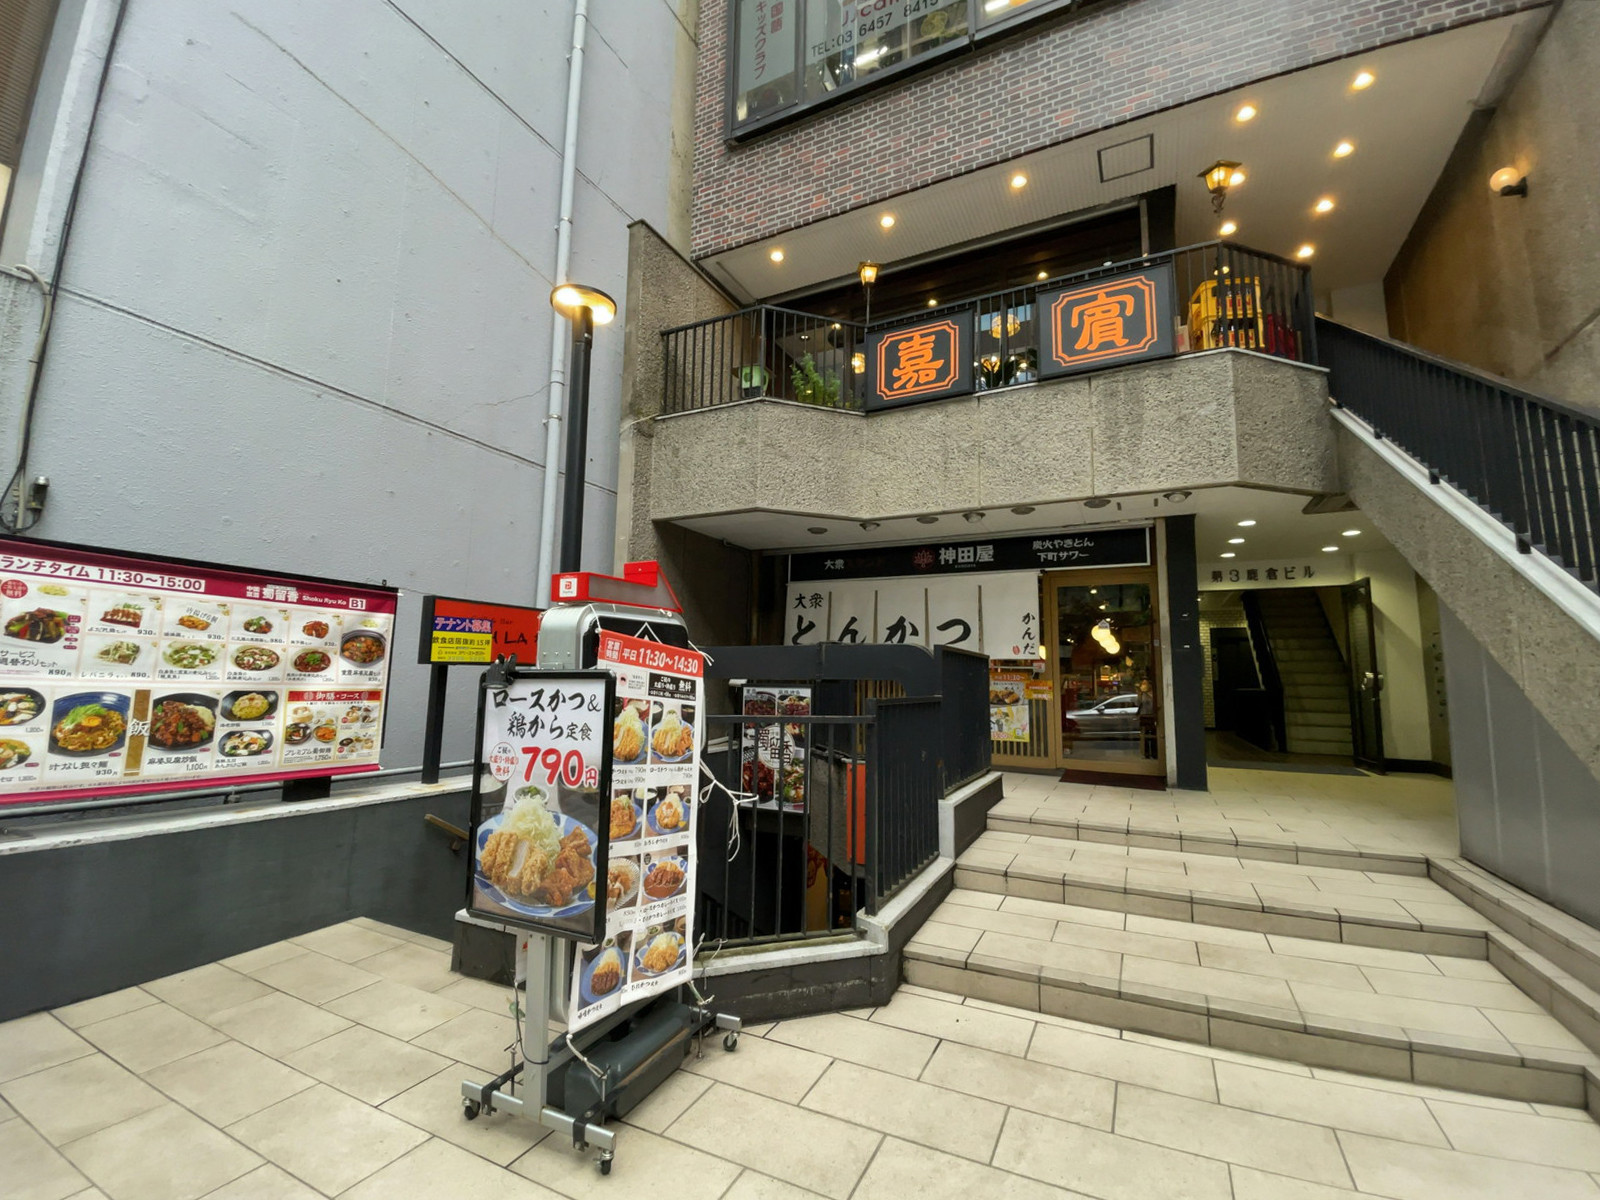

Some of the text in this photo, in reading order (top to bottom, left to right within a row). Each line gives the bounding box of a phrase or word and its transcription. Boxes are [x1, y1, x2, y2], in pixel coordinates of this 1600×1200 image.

[858, 12, 893, 37] 6457
[892, 333, 946, 391] 嘉
[939, 545, 994, 565] 神田屋
[1037, 551, 1090, 562] 下町サワー
[0, 556, 91, 578] ランチタイム
[351, 599, 364, 609] B1
[793, 592, 824, 609] 大衆
[434, 617, 491, 633] テナント募集
[791, 615, 972, 645] とんかつ
[1021, 612, 1036, 656] かんだ
[622, 648, 638, 660] 平日
[128, 719, 150, 737] 飯
[507, 711, 593, 741] 鶏から定食
[521, 746, 598, 788] 790円
